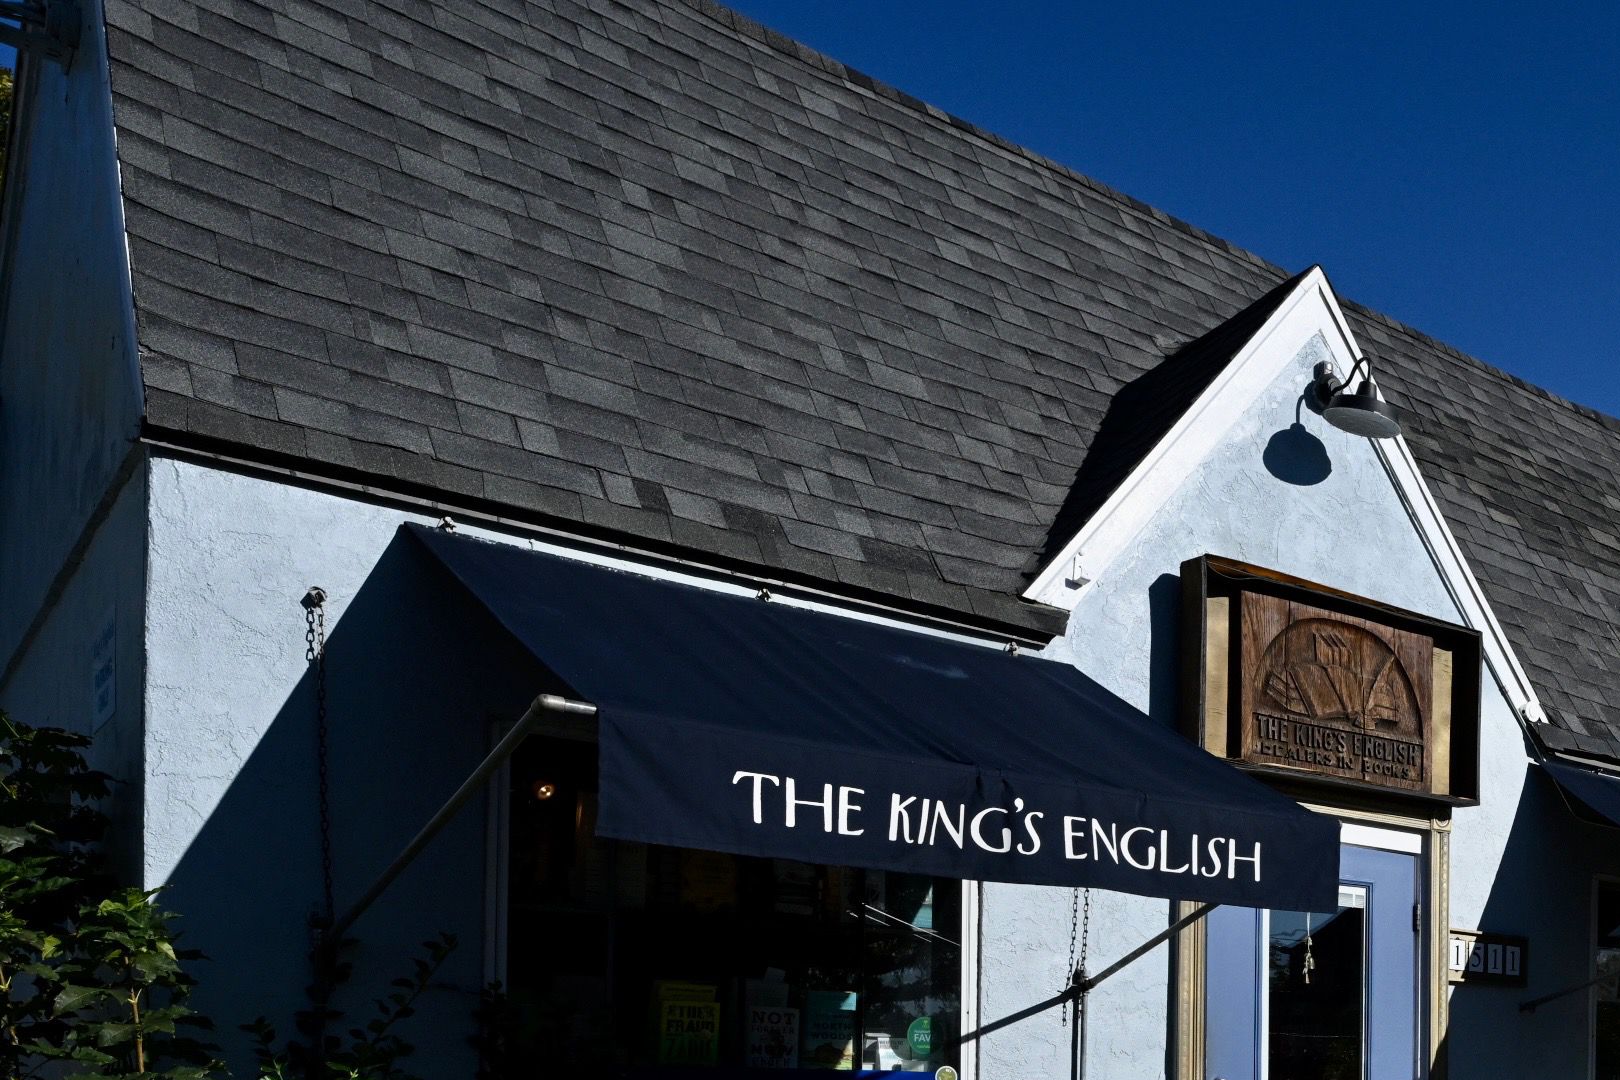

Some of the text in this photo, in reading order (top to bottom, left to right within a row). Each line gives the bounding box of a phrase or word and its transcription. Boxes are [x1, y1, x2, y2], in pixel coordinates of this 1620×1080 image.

[1258, 714, 1417, 766] THE KING'S ENGLISH
[1336, 753, 1353, 770] IN
[1363, 758, 1410, 780] BOOKS
[732, 770, 1261, 882] THE KING'S ENGLISH
[1455, 945, 1518, 972] 1511
